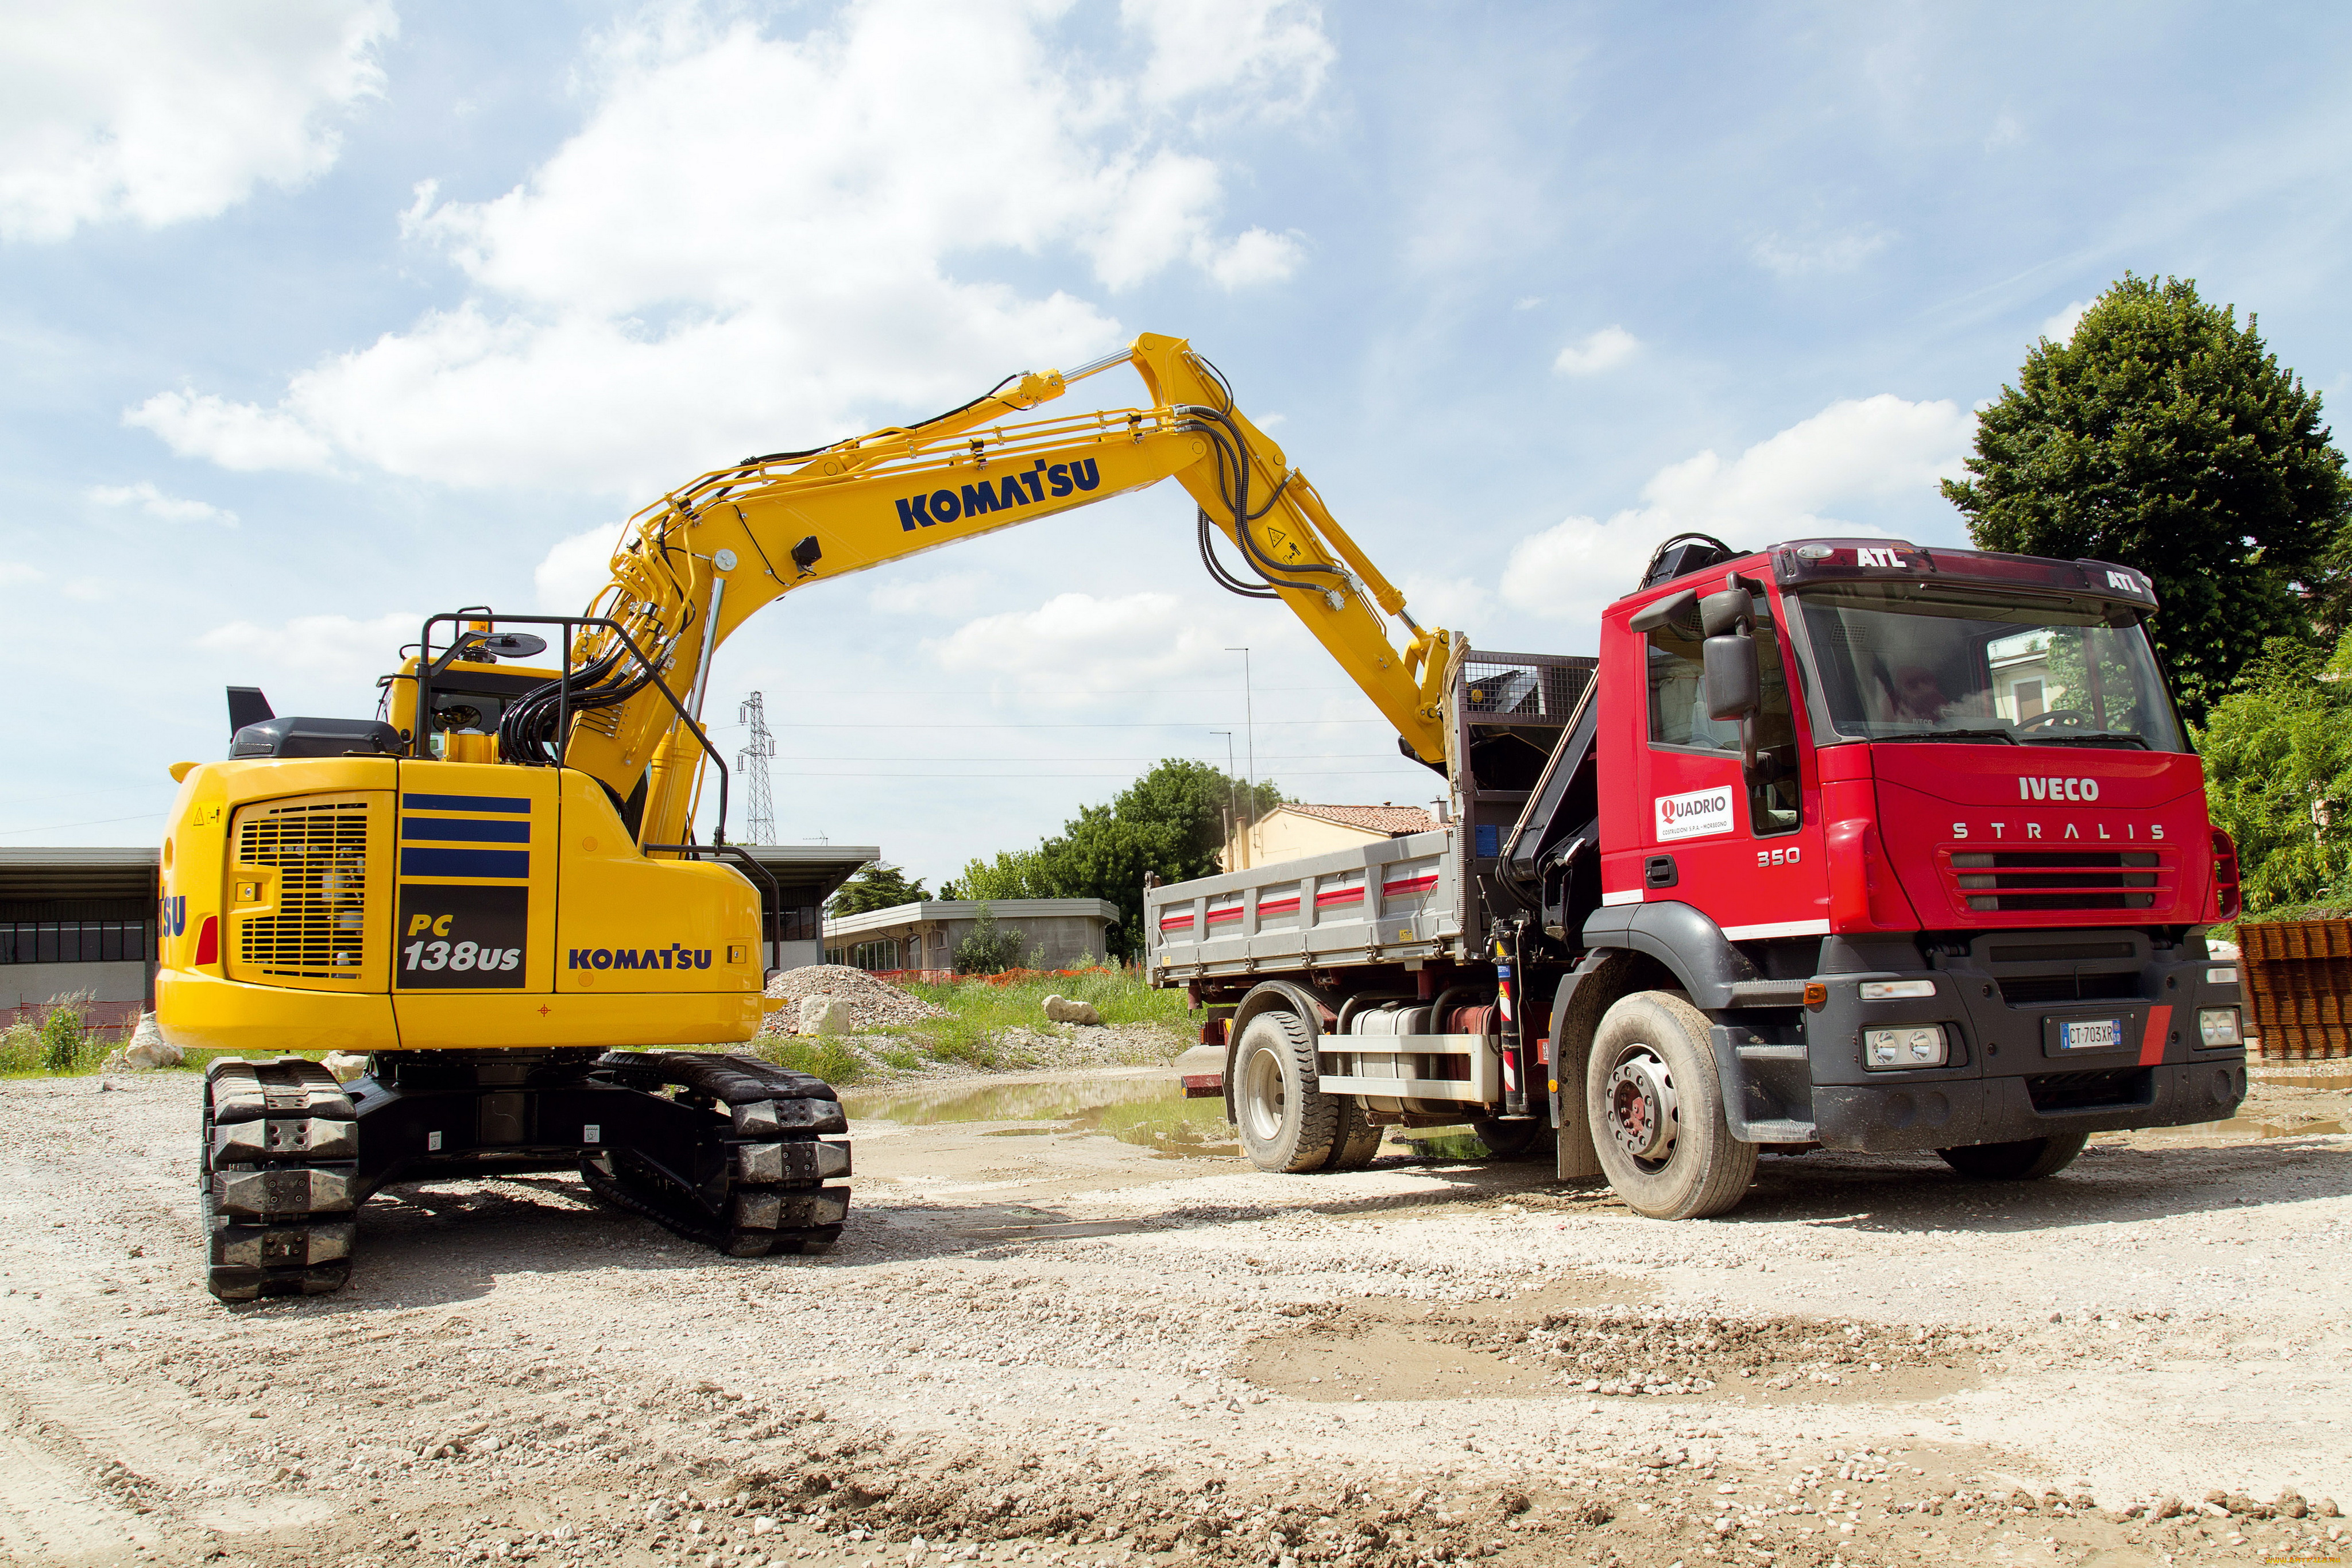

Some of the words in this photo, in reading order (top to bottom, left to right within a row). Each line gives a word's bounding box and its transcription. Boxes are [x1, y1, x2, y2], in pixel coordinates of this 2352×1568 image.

[895, 458, 1100, 532] KOMATSU
[1857, 548, 1906, 567] ATL
[2106, 570, 2142, 593] ATL
[2018, 777, 2099, 801] IVECO
[1662, 796, 1726, 824] QUADRIO
[1662, 827, 1688, 835] COSTRUZIONI
[1953, 823, 2164, 839] STRALIS
[1757, 847, 1801, 868] 350
[407, 914, 453, 936] PC
[568, 943, 712, 970] KOMATSU
